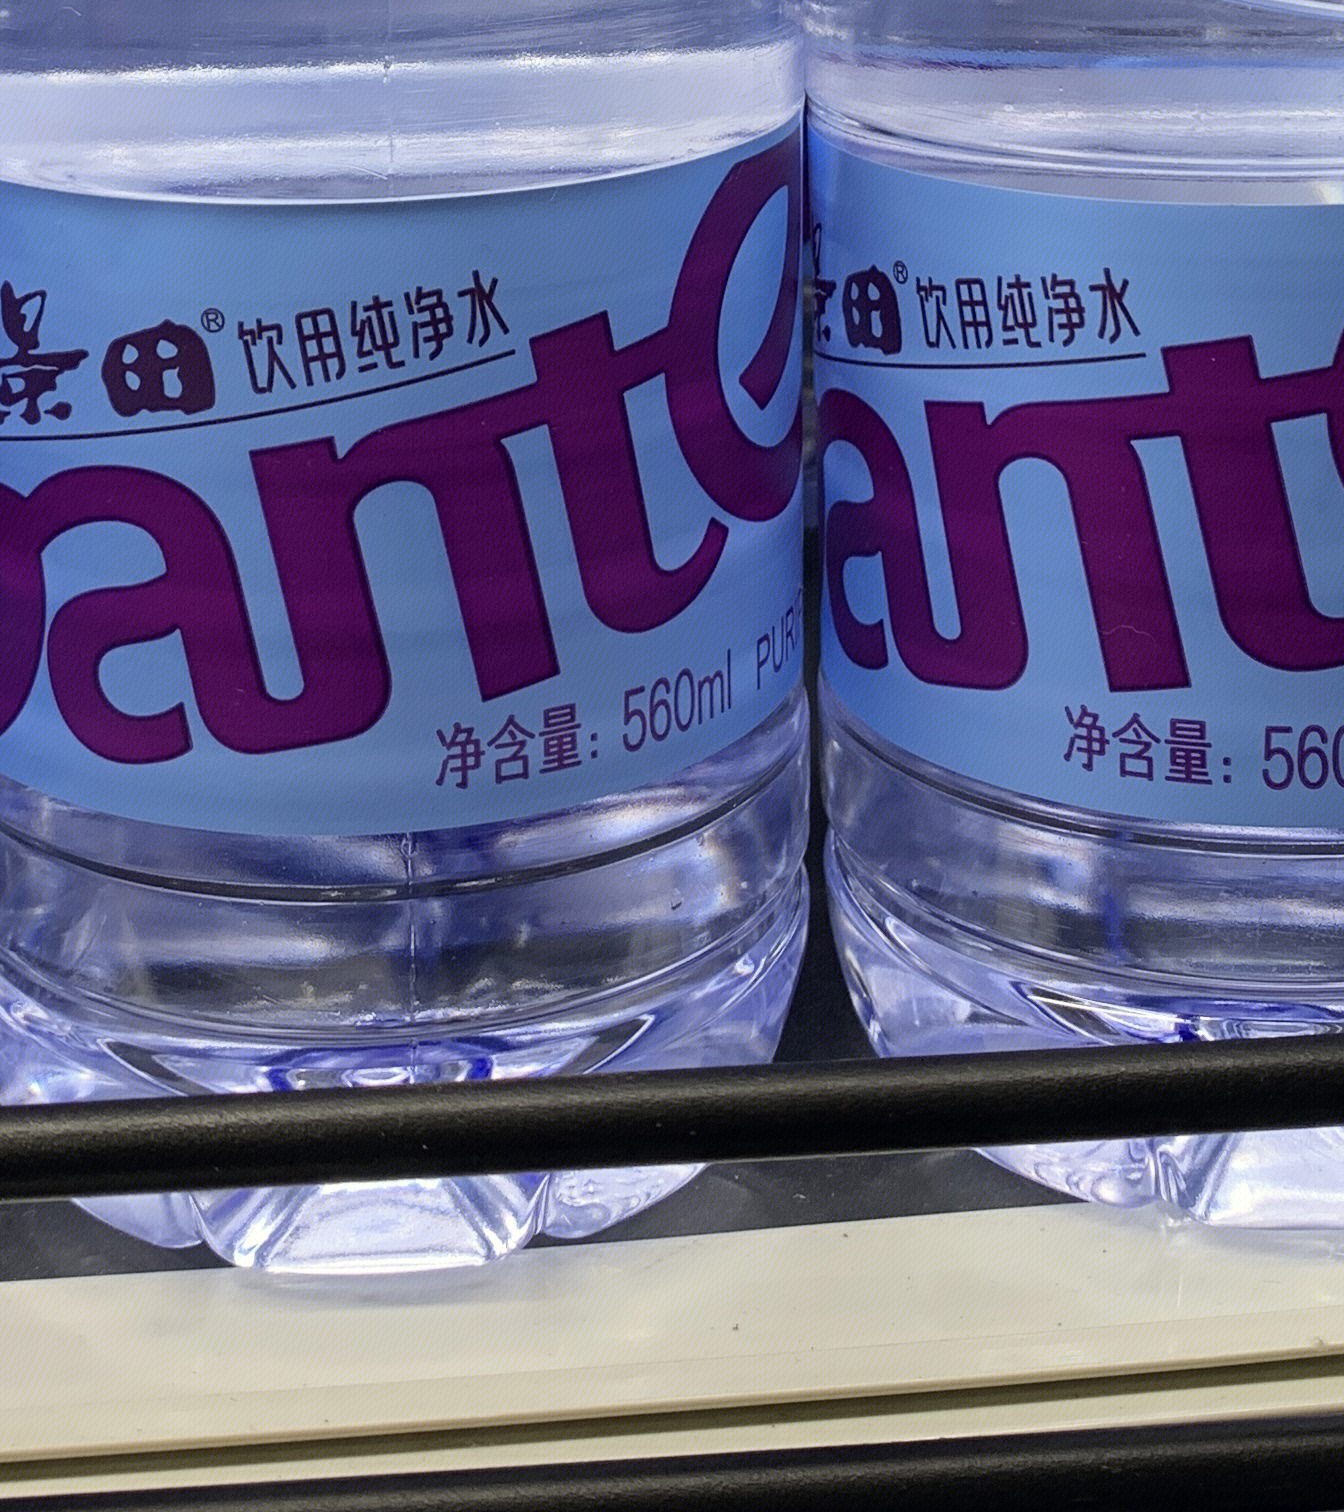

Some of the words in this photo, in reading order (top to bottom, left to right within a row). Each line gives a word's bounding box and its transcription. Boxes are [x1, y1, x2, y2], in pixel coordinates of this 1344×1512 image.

[237, 269, 509, 394] 饮用纯净水
[915, 267, 1141, 350] 饮用纯净水
[435, 703, 599, 789] 净含量：
[622, 648, 732, 752] 560ml
[1064, 703, 1233, 786] 净含量：
